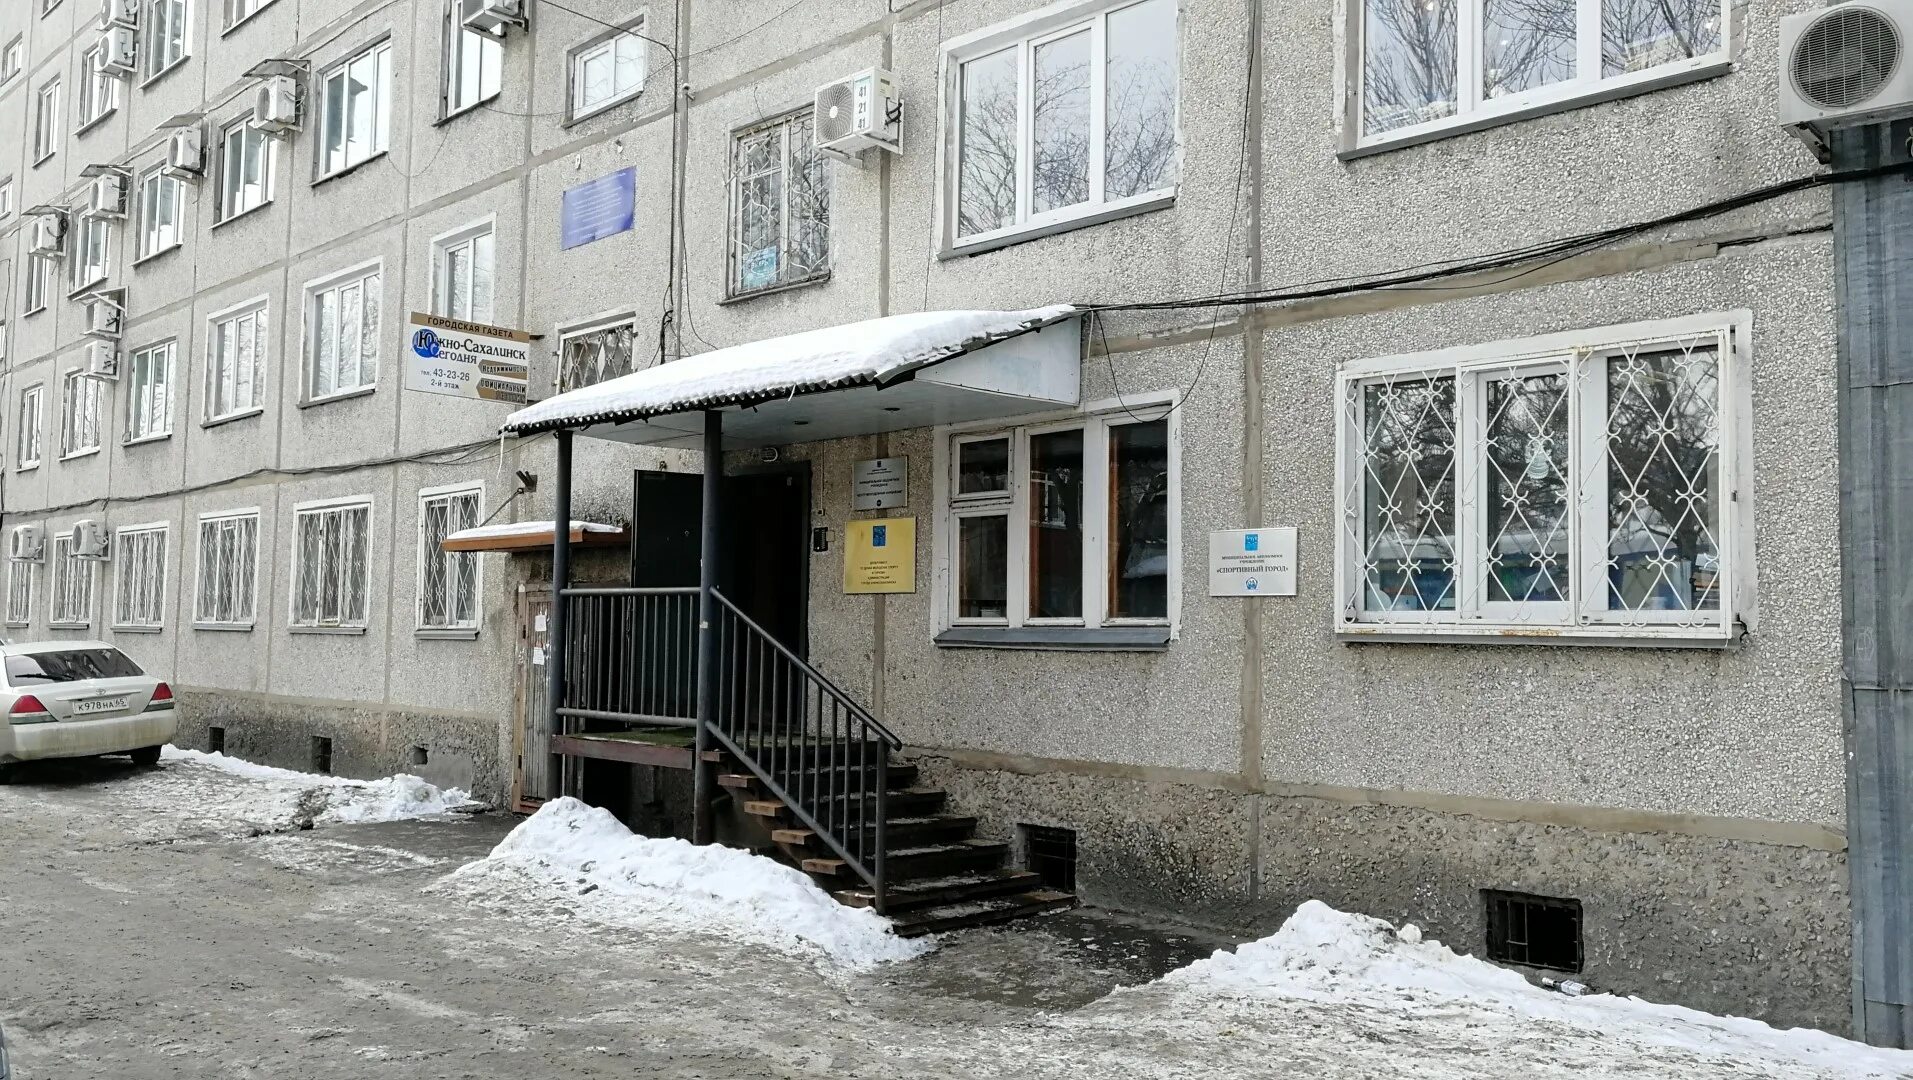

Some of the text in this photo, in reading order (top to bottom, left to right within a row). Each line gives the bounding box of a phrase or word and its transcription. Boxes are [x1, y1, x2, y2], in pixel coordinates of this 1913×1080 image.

[427, 317, 514, 339] ГОРОДСКАЯ ГАЗЕТА
[417, 330, 526, 360] Южно-Сахалинск
[430, 378, 460, 390] 2-й этаж
[433, 368, 470, 382] 43-23-26
